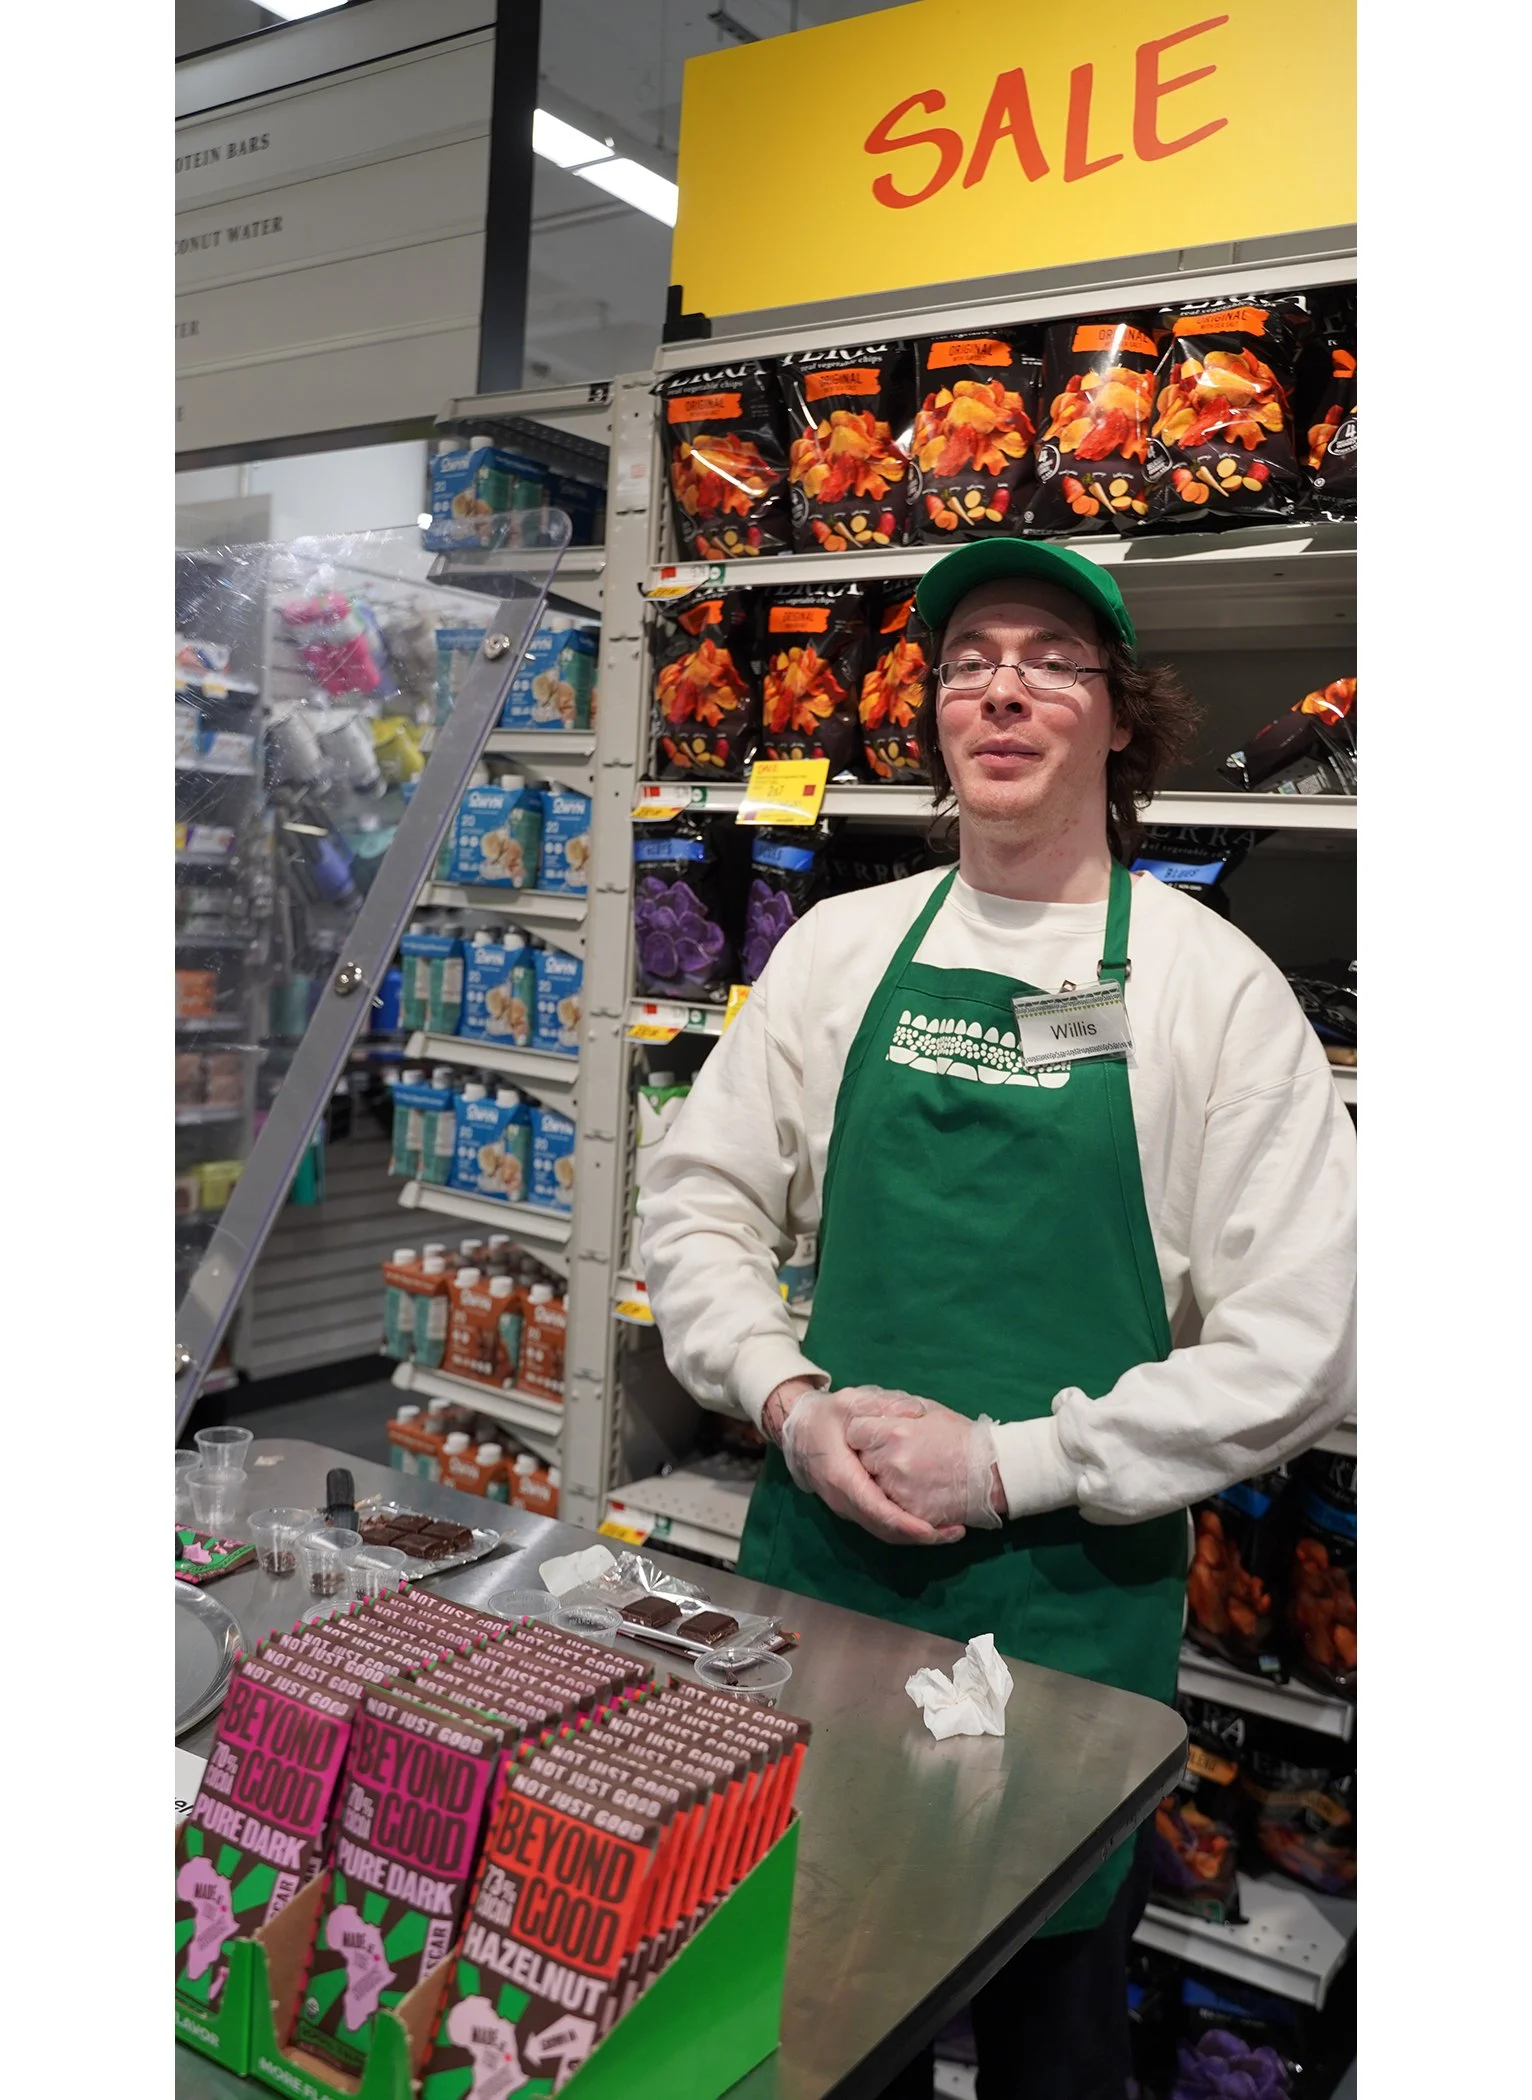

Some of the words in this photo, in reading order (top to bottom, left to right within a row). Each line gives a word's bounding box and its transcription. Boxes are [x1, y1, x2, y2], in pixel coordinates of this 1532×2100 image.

[864, 14, 1230, 210] SALE
[226, 133, 270, 160] BARS
[226, 216, 282, 243] WATER
[1050, 1021, 1098, 1041] Willis
[262, 1648, 294, 1669] NOT
[292, 1661, 329, 1683] JUST
[279, 1633, 309, 1656] NOT
[309, 1646, 346, 1668] JUST
[343, 1661, 386, 1685] GOOD
[414, 1676, 447, 1696] NOT
[242, 1661, 274, 1683] NOT
[270, 1675, 310, 1699] JUST
[307, 1691, 350, 1717] GOOD
[224, 1682, 339, 1773] BEYOND
[367, 1697, 398, 1720] NOT
[397, 1711, 439, 1736] JUST
[437, 1727, 484, 1754] GOOD
[608, 1716, 644, 1738] NOT
[645, 1731, 687, 1754] JUST
[357, 1723, 477, 1814] BEYOND
[530, 1756, 568, 1780] NOT
[566, 1771, 612, 1798] JUST
[612, 1788, 662, 1818] GOOD
[588, 1759, 631, 1782] JUST
[631, 1776, 680, 1803] GOOD
[191, 1791, 246, 1842] PURE
[239, 1816, 307, 1870] DARK
[512, 1774, 551, 1800] NOT
[548, 1790, 595, 1819] JUST
[593, 1810, 645, 1840] GOOD
[338, 1837, 390, 1890] PURE
[385, 1863, 457, 1916] DARK
[497, 1800, 636, 1905] BEYOND
[462, 1921, 608, 2016] HAZELNUT
